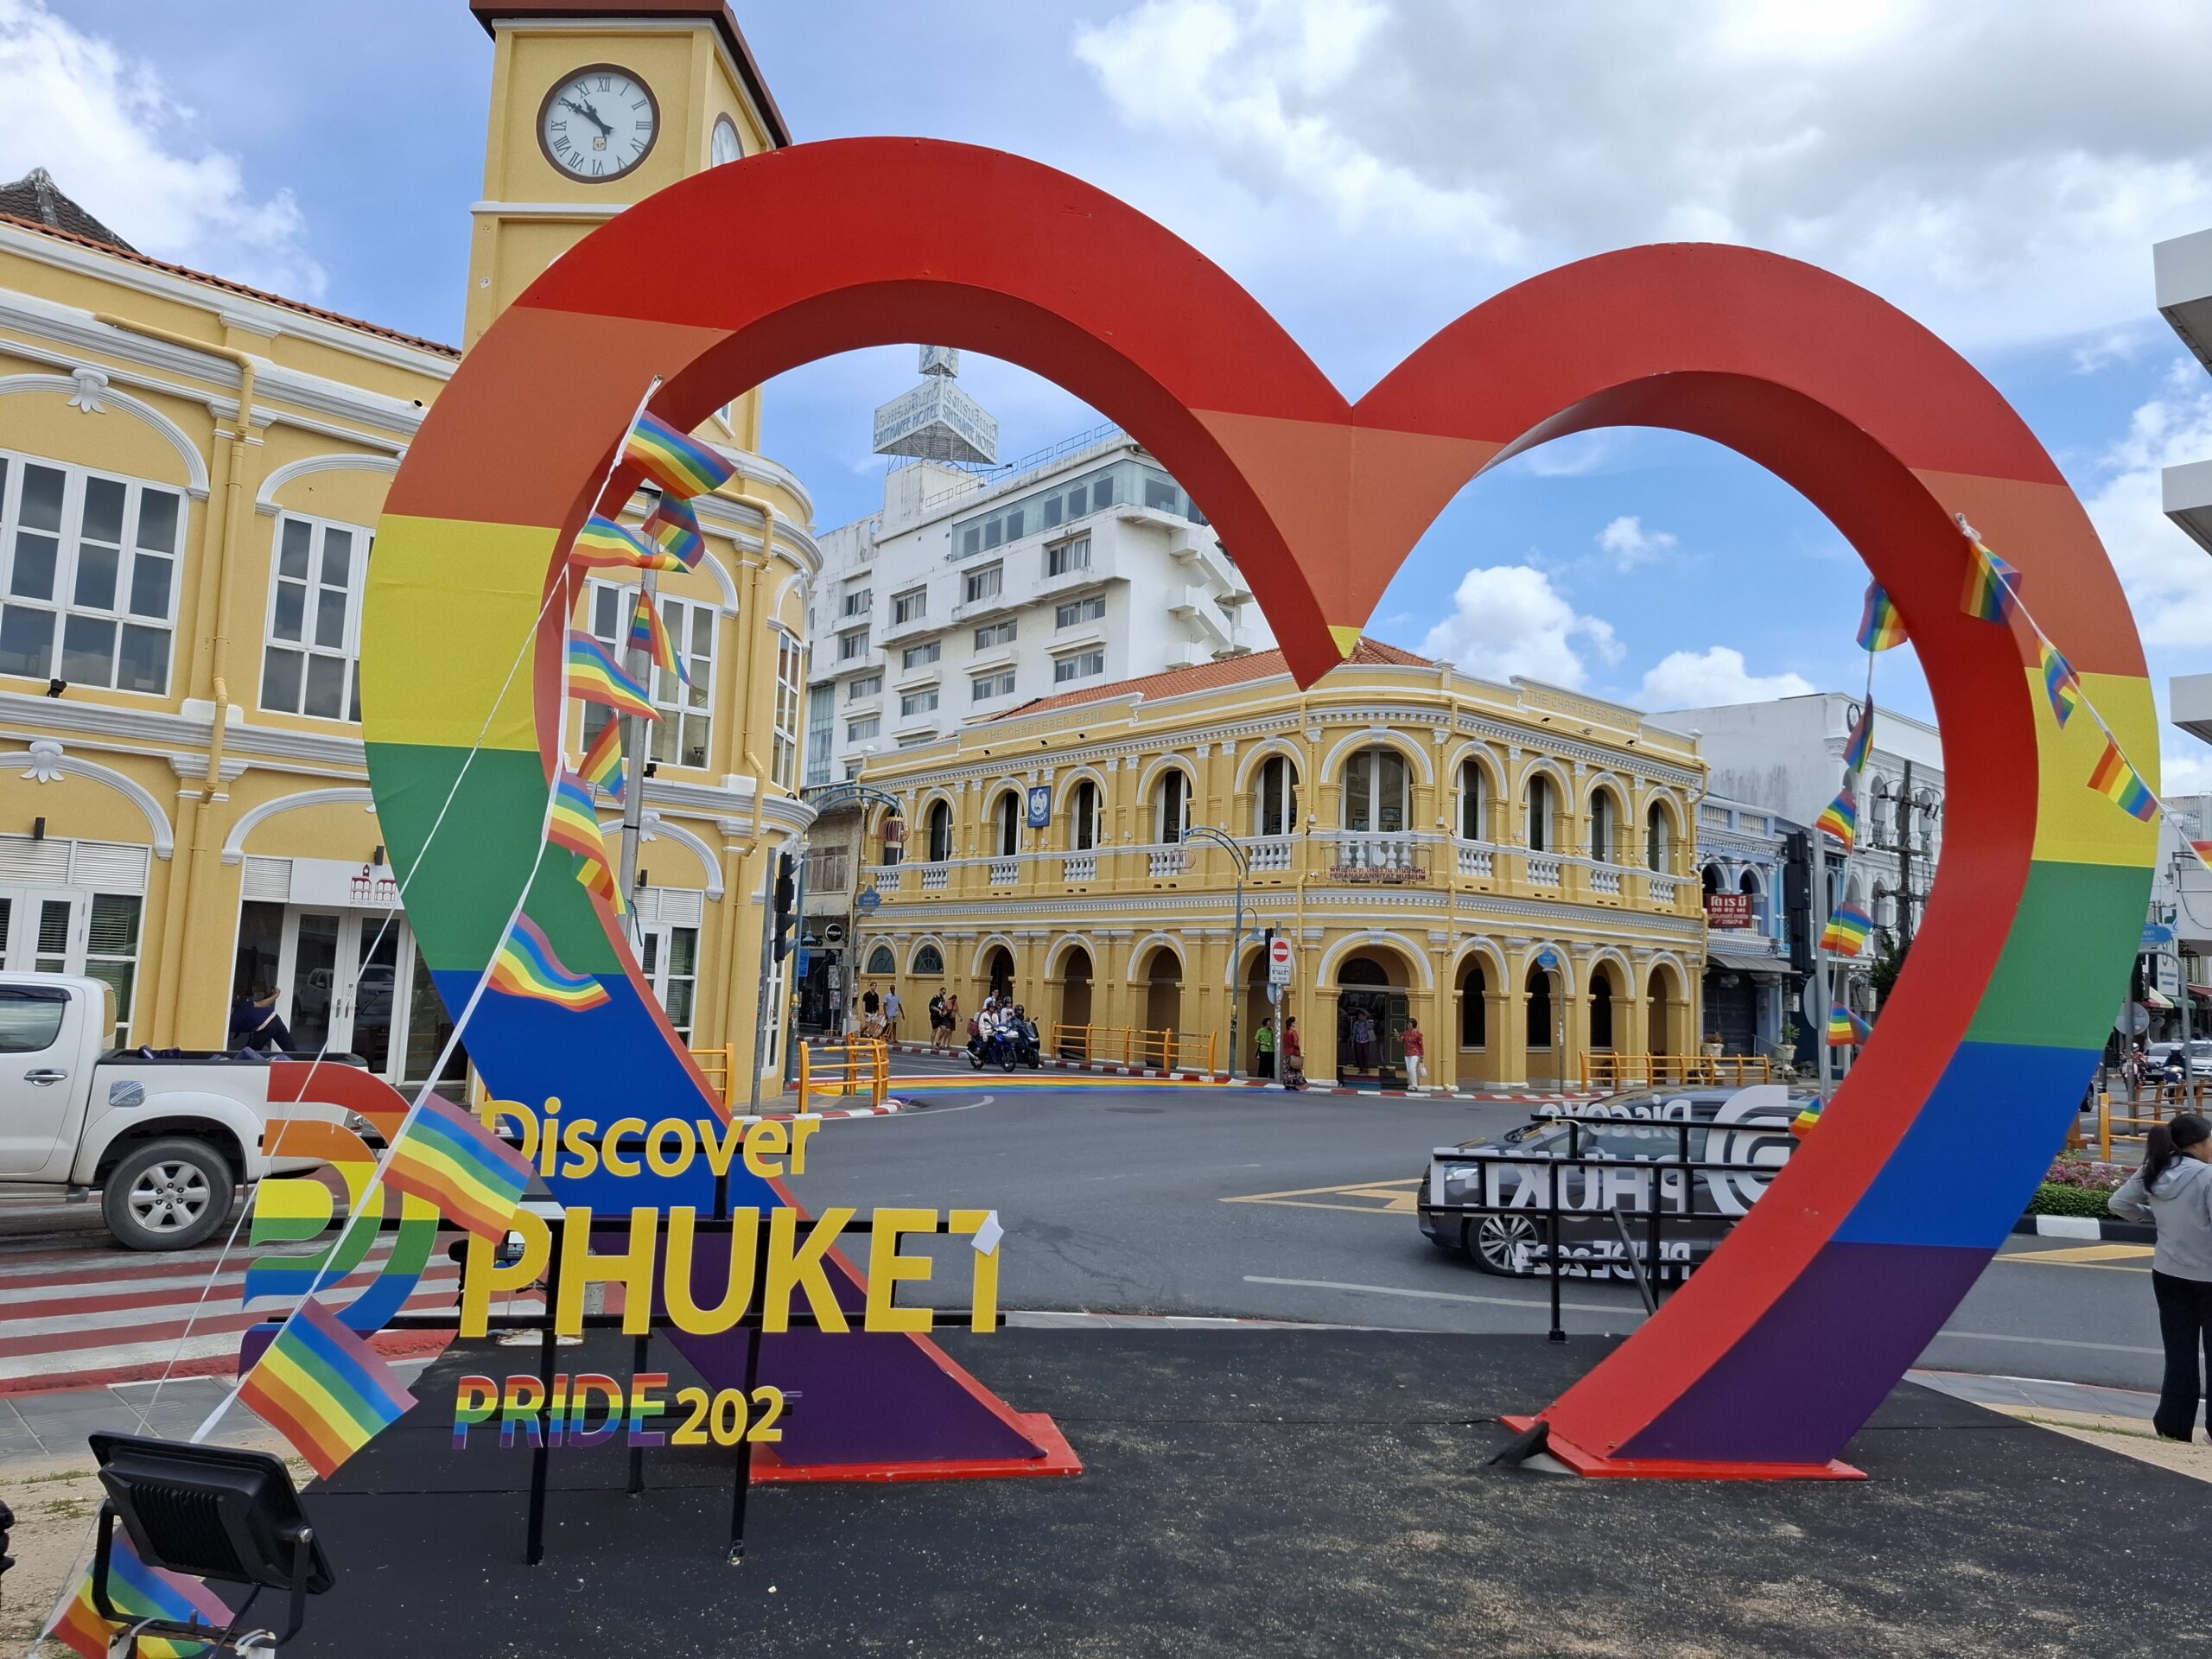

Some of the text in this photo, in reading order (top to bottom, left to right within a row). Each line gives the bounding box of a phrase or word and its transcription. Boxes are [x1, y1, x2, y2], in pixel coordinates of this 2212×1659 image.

[575, 81, 591, 99] XI
[597, 77, 611, 92] XII
[632, 99, 646, 111] II
[550, 119, 567, 131] IX
[636, 120, 652, 130] III
[553, 135, 572, 157] VIII
[567, 151, 584, 172] VII
[591, 159, 605, 175] VI
[616, 155, 628, 169] V
[874, 404, 939, 447] SINTHAVEE HOTEL
[943, 404, 996, 458] SINTHAVEE HOTEL
[1528, 690, 1634, 728] THE CHARTERED BANK
[983, 709, 1105, 741] THE CHARTERED BANK
[479, 1096, 820, 1179] Discover
[459, 1206, 1001, 1338] PHUKET
[452, 1372, 785, 1450] PRIDE 202
